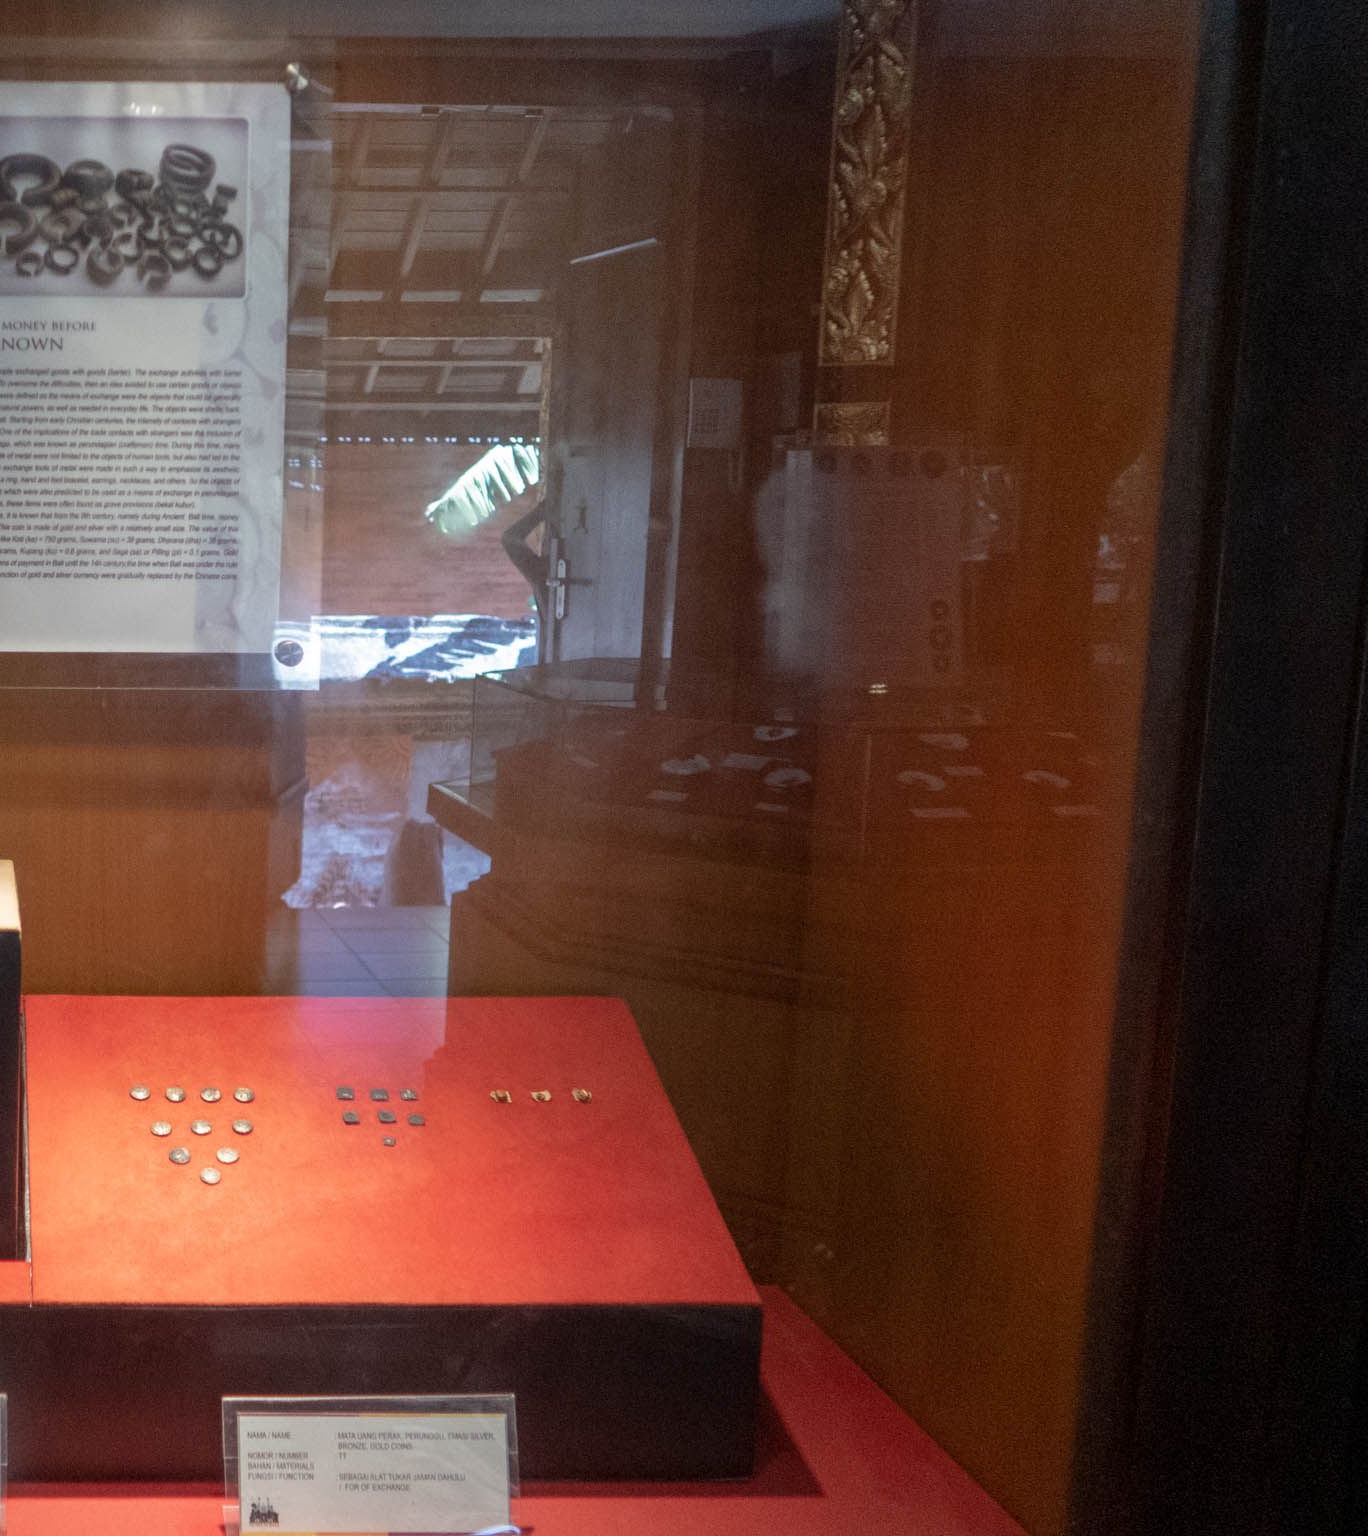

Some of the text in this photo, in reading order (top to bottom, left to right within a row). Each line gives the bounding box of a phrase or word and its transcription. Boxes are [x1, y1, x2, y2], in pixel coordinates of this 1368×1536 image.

[1, 320, 47, 332] MONEY
[52, 321, 96, 332] BEFORE
[247, 1431, 267, 1440] NAMA
[271, 1431, 290, 1440] NAME
[247, 1452, 274, 1460] NOMOR
[278, 1452, 308, 1460] NUMBER
[247, 1462, 272, 1470] BAHAN
[276, 1462, 315, 1470] MATERIALS
[247, 1472, 274, 1480] FUNGSI
[279, 1472, 315, 1480] FUNCTION
